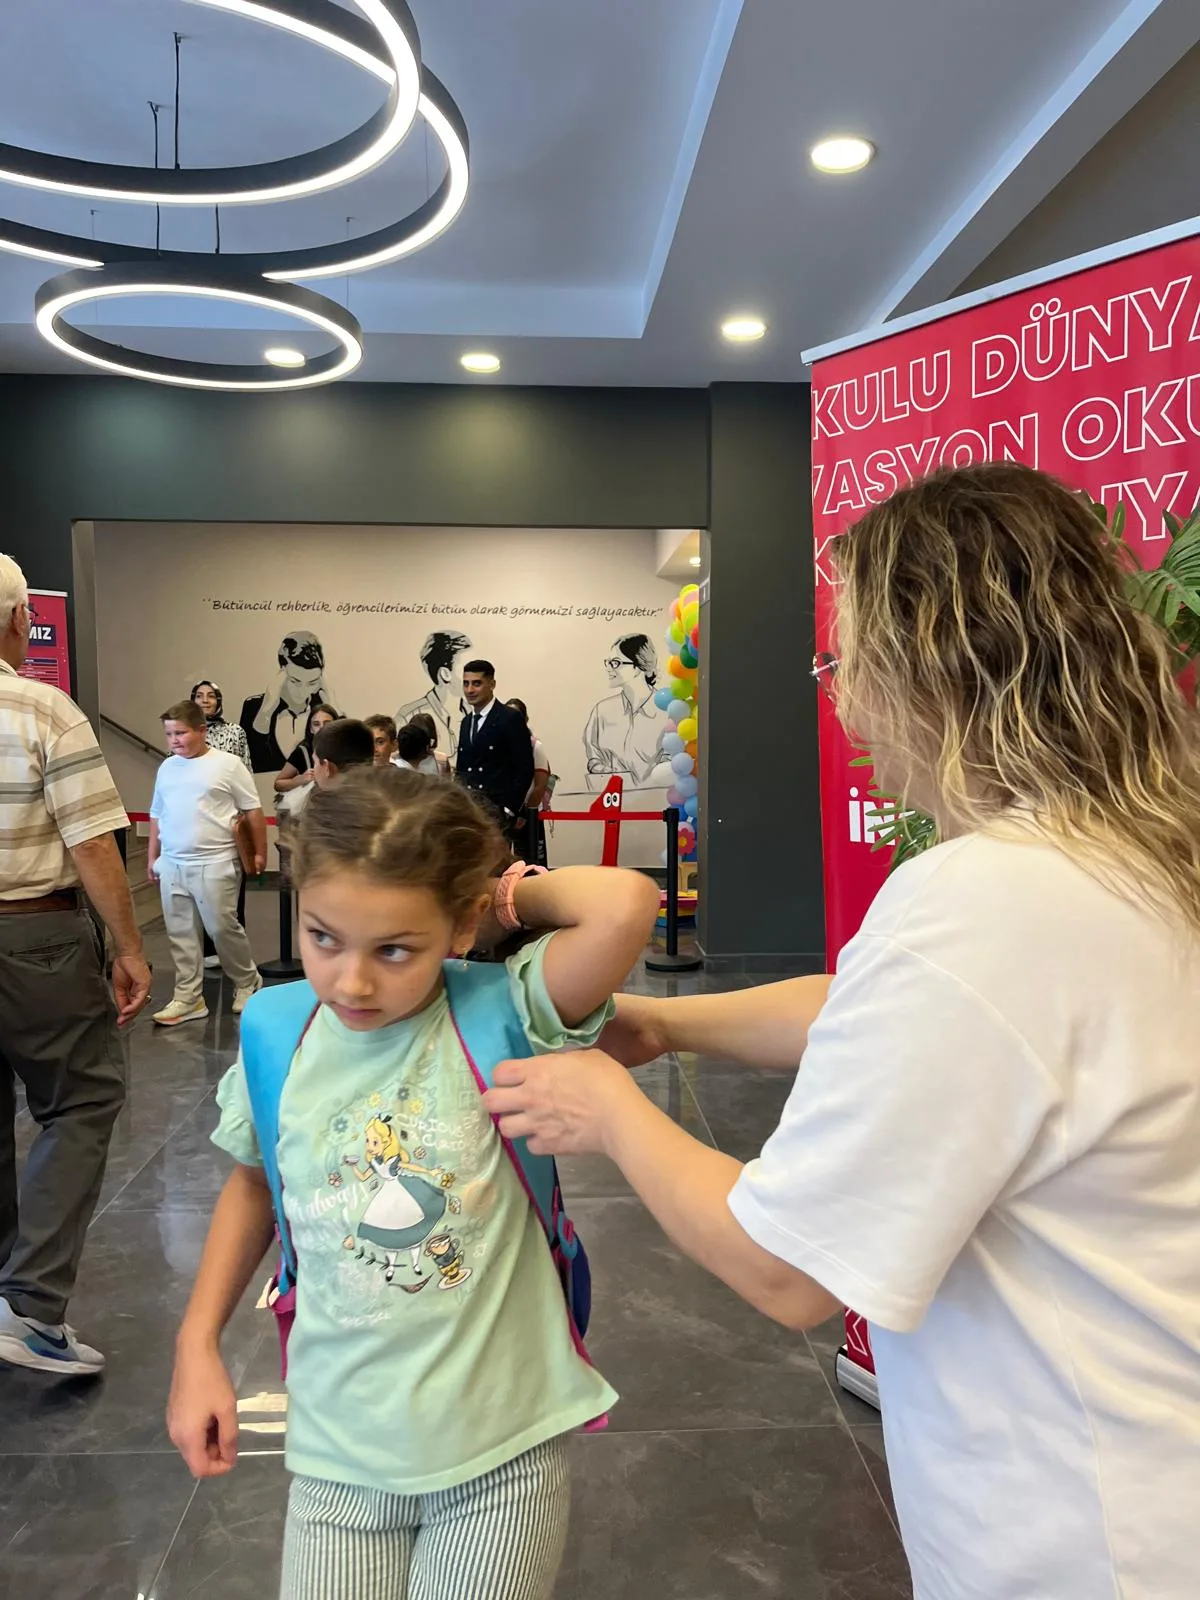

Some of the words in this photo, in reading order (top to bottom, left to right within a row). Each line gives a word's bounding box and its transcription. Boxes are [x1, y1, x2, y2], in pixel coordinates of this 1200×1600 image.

[971, 274, 1200, 400] DÜNY
[335, 601, 429, 616] öğrencilerimizi
[431, 602, 468, 615] bütün
[469, 603, 509, 616] olarak
[509, 604, 574, 619] görmemizi
